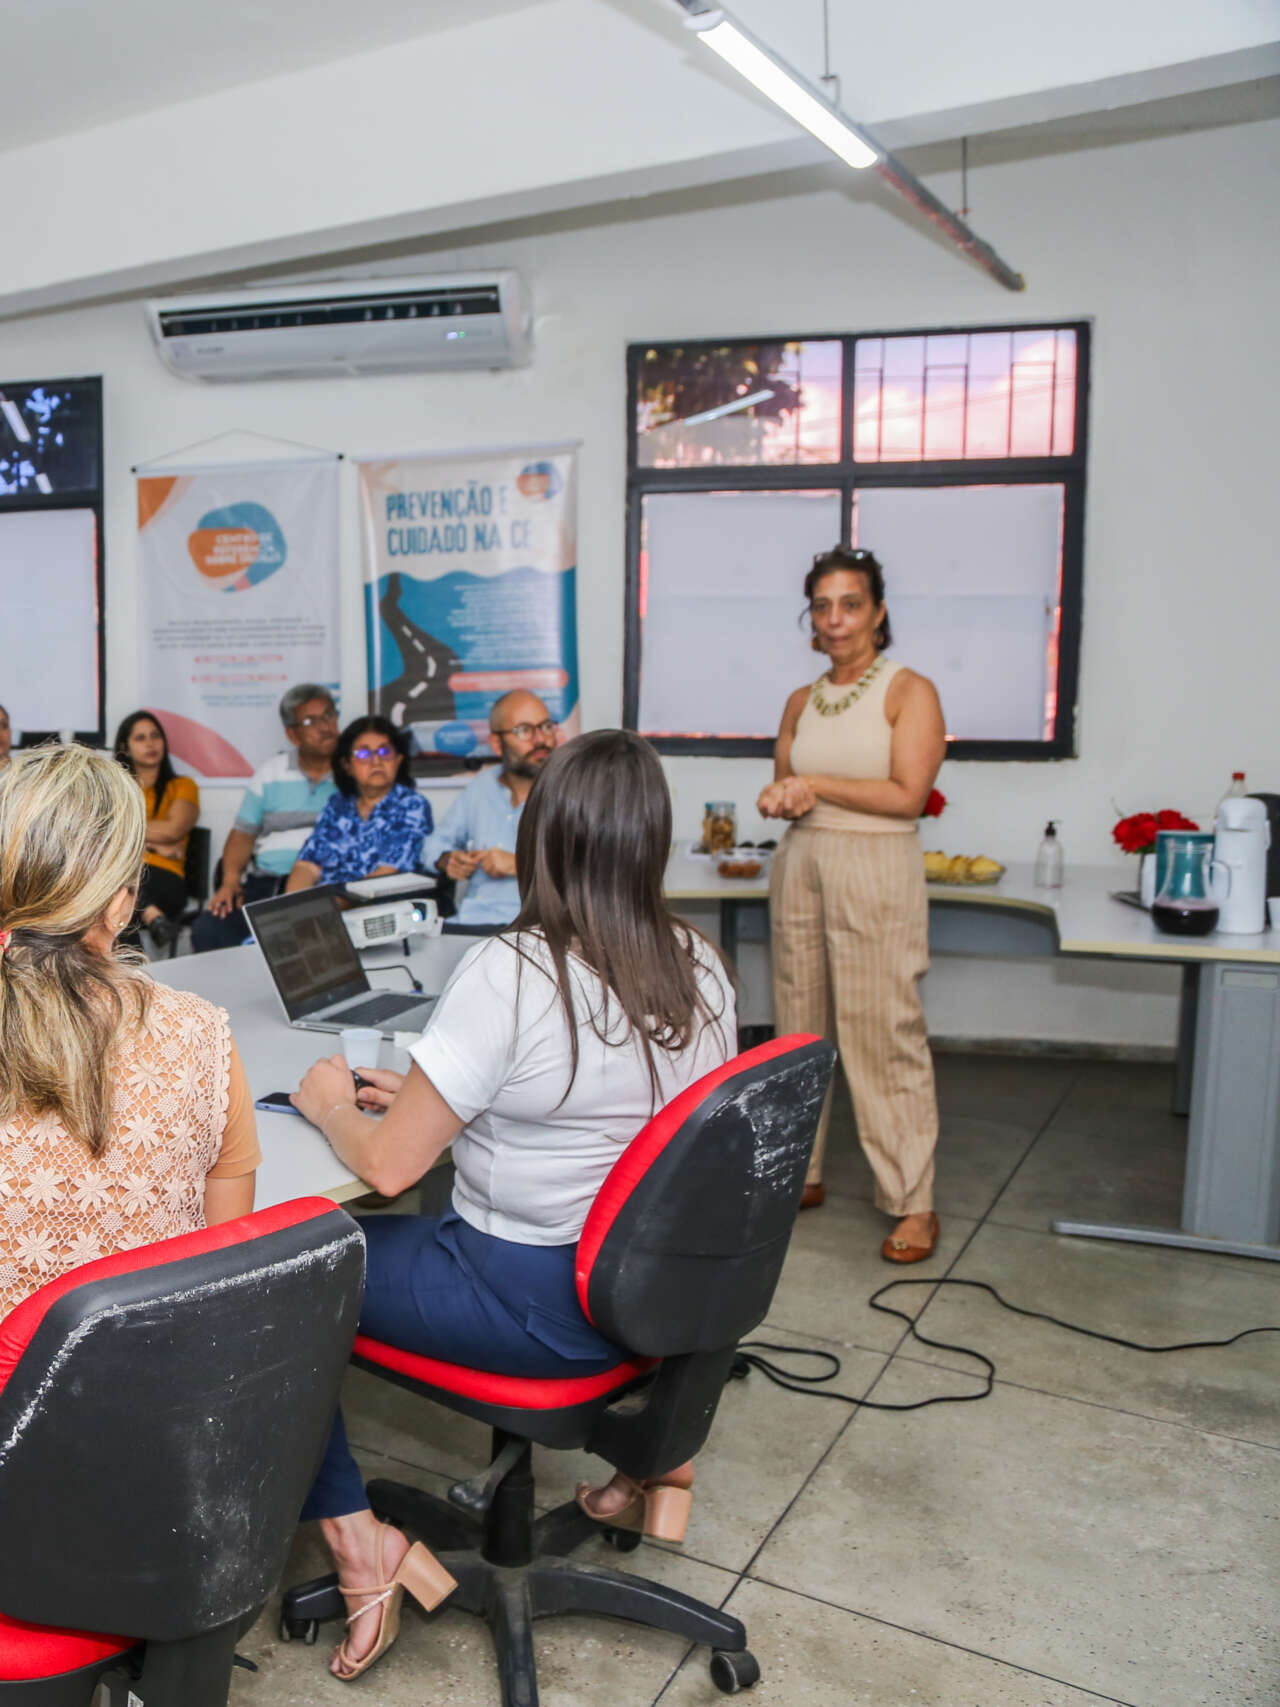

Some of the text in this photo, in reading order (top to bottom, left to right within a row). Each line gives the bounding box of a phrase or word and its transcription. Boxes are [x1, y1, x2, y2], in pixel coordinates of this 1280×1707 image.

[385, 480, 493, 521] PREVENÇÃO
[387, 523, 467, 556] CUIDADO
[474, 522, 503, 552] NA
